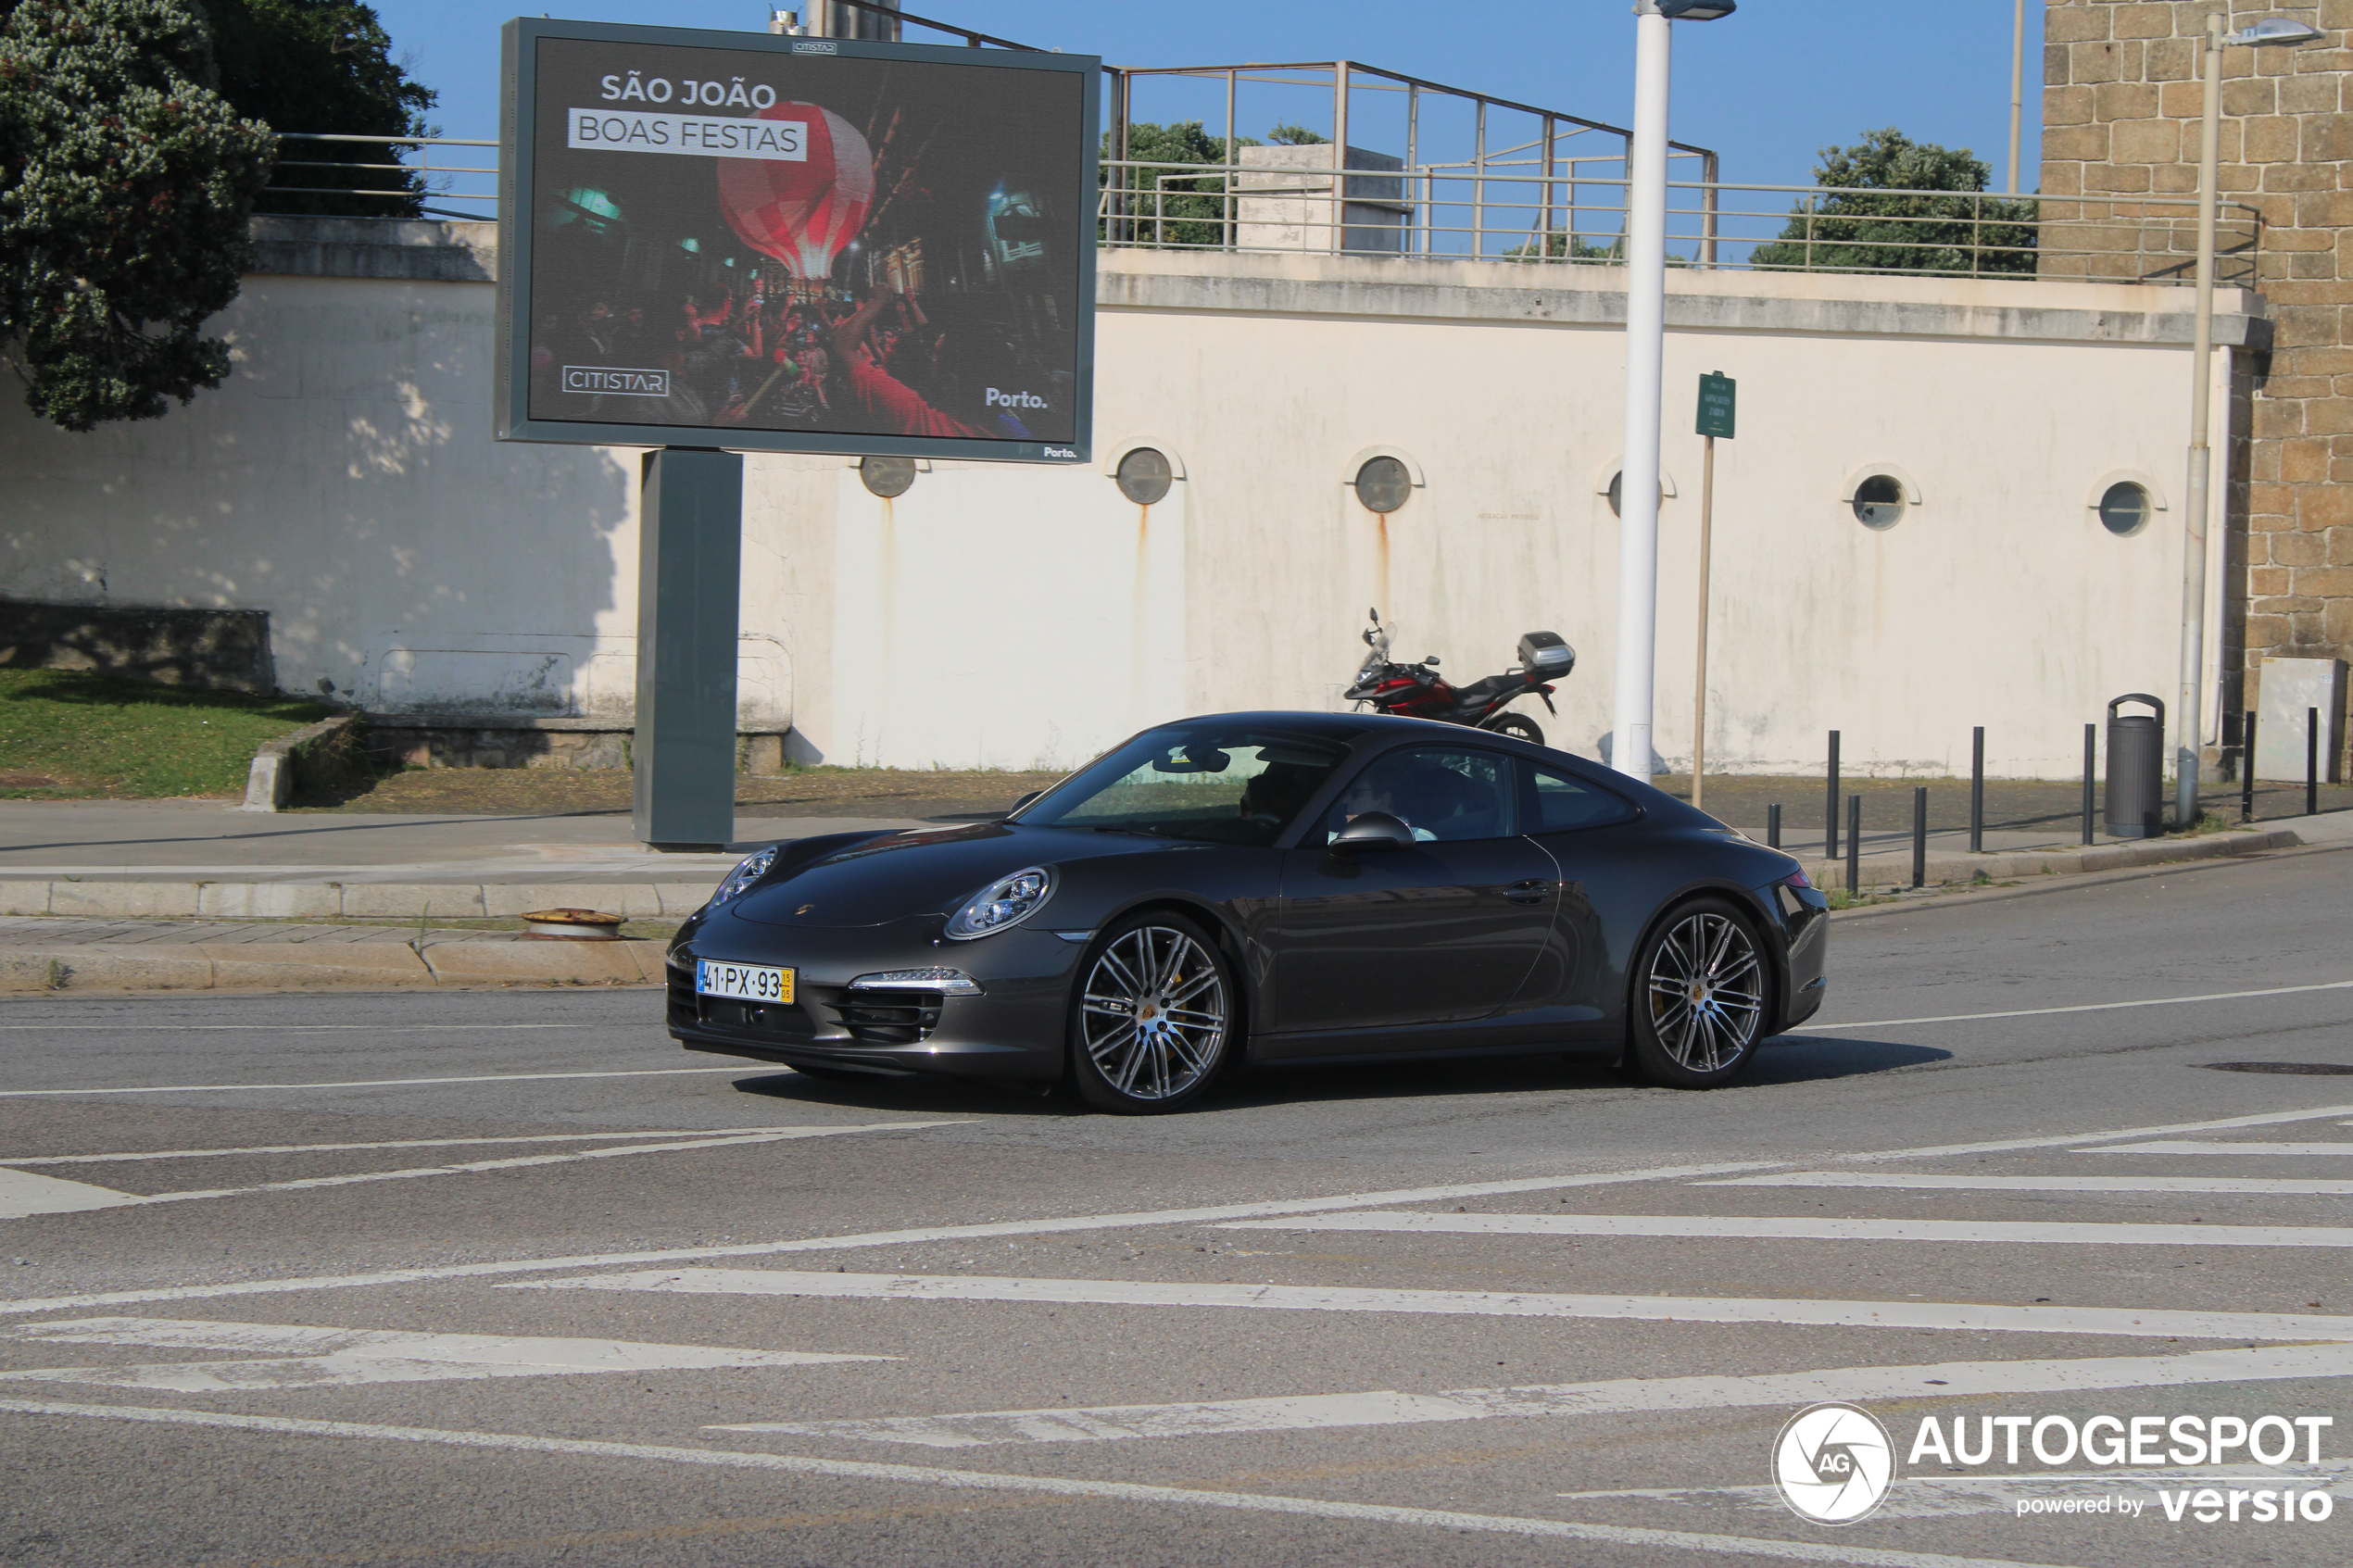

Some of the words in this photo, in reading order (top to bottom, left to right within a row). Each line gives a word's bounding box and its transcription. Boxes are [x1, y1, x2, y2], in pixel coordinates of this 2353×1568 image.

[795, 42, 835, 53] CITISTAR
[601, 69, 673, 103] SÃO
[681, 77, 776, 109] JOÃO
[579, 116, 669, 144] BOAS
[682, 122, 798, 152] FESTAS
[568, 371, 662, 391] CITISTAR
[986, 387, 1048, 408] Porto.
[1043, 446, 1076, 458] Porto.
[782, 973, 790, 983] 15
